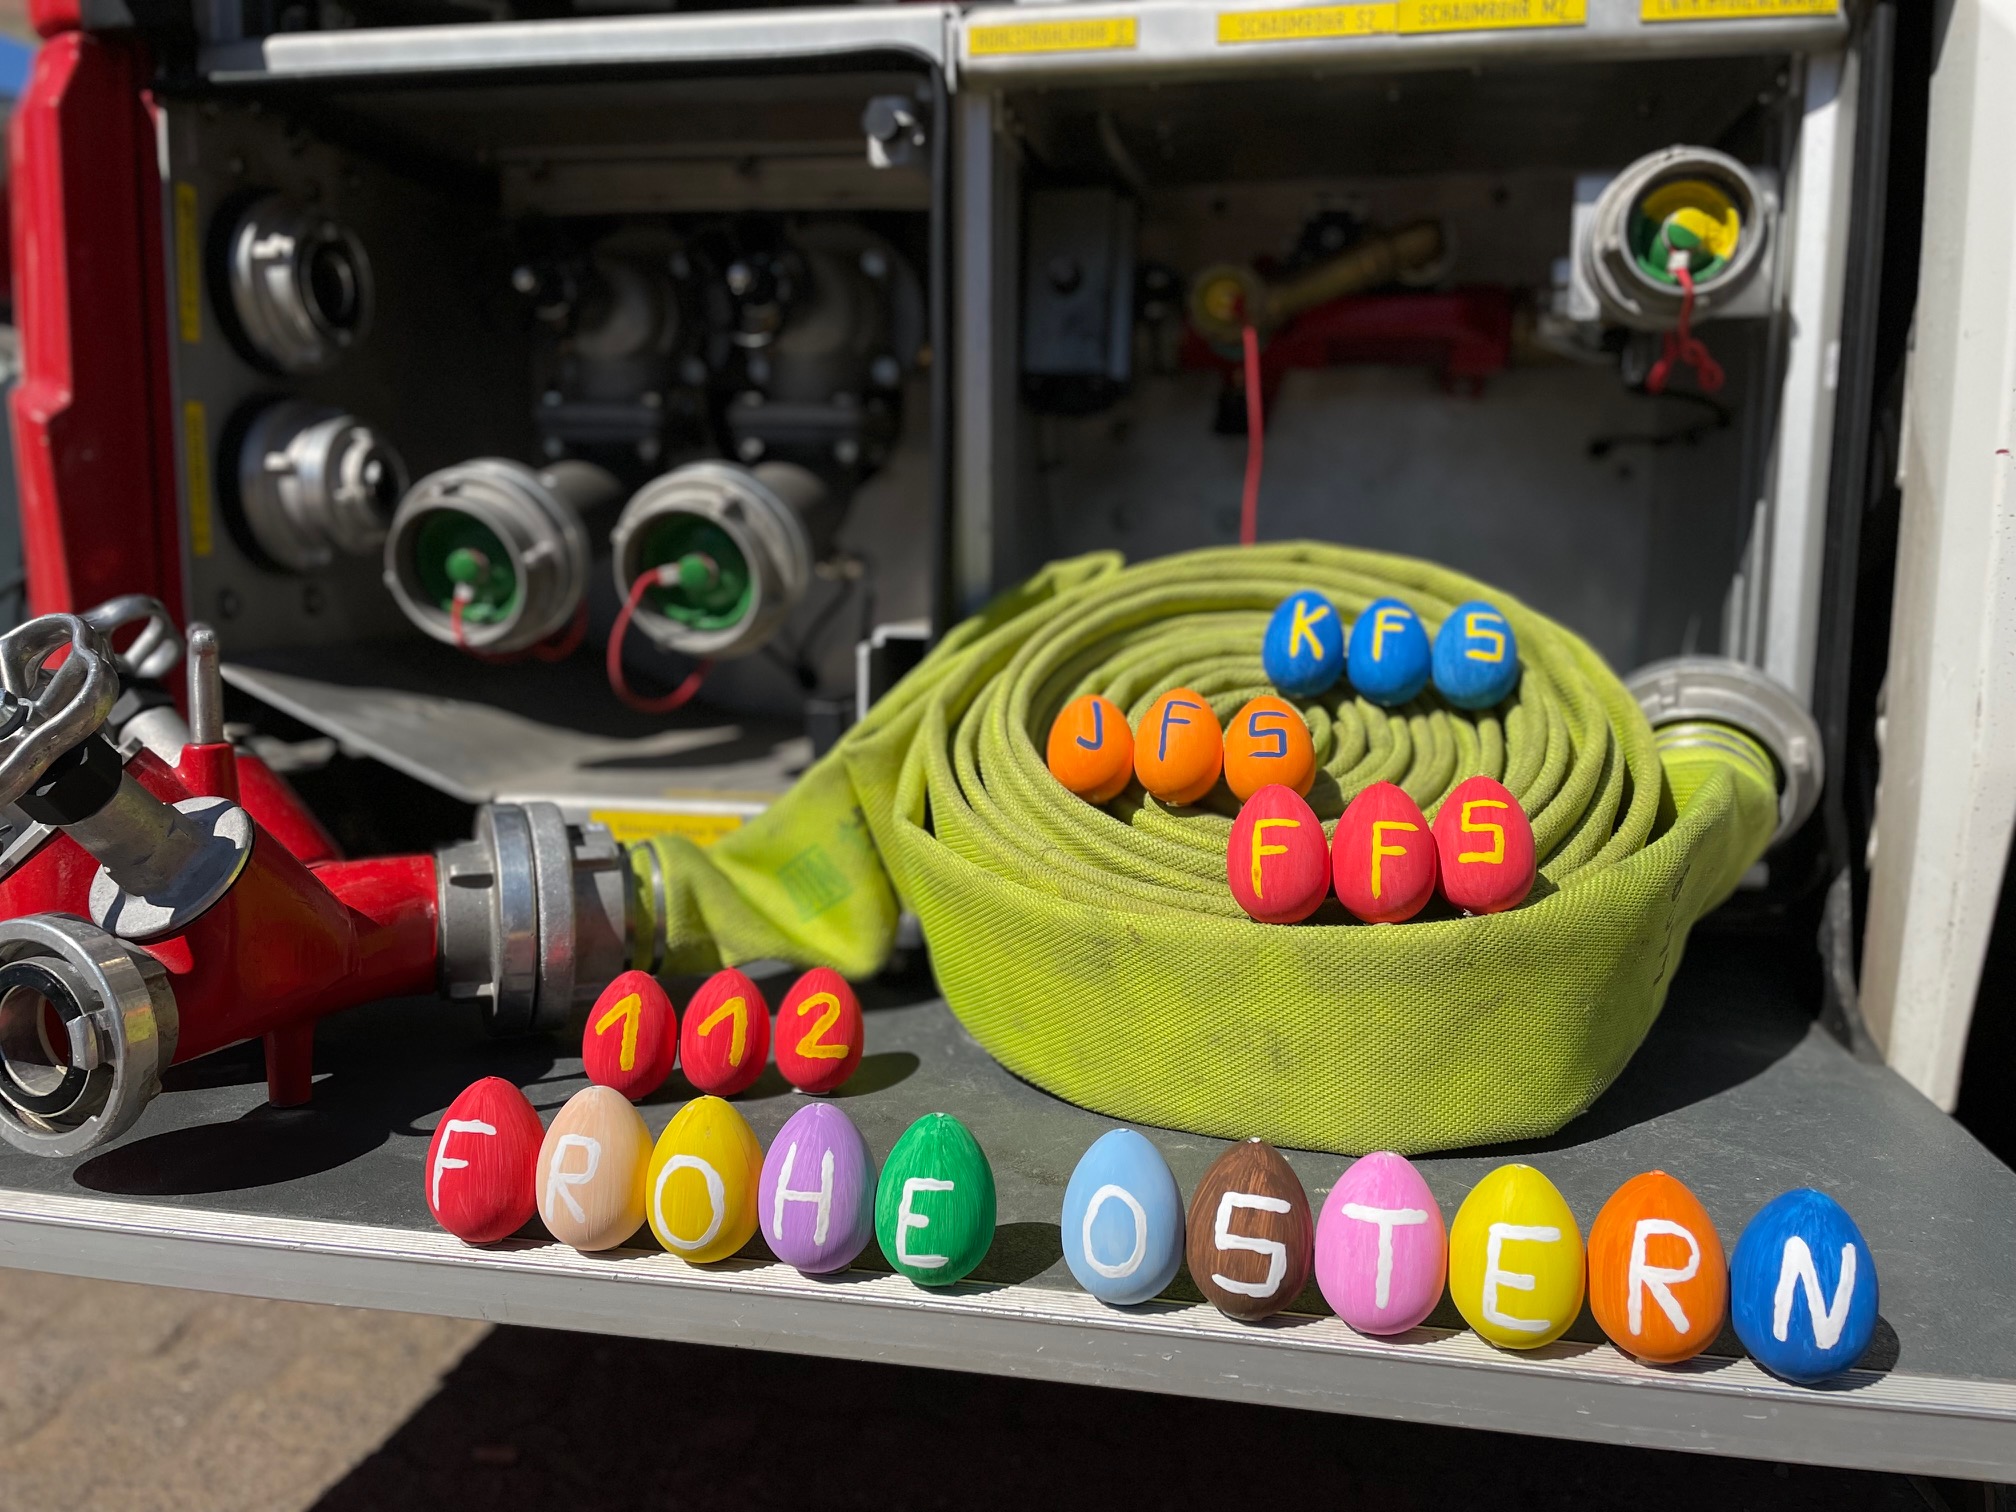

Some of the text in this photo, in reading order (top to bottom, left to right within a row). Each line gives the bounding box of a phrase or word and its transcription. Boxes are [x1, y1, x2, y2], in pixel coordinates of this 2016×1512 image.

[1289, 600, 1505, 662] KFS
[1076, 700, 1289, 762] JFS
[1251, 799, 1509, 899] FFS
[595, 992, 849, 1071] 112
[432, 1119, 1857, 1350] FROHE OSTERN
